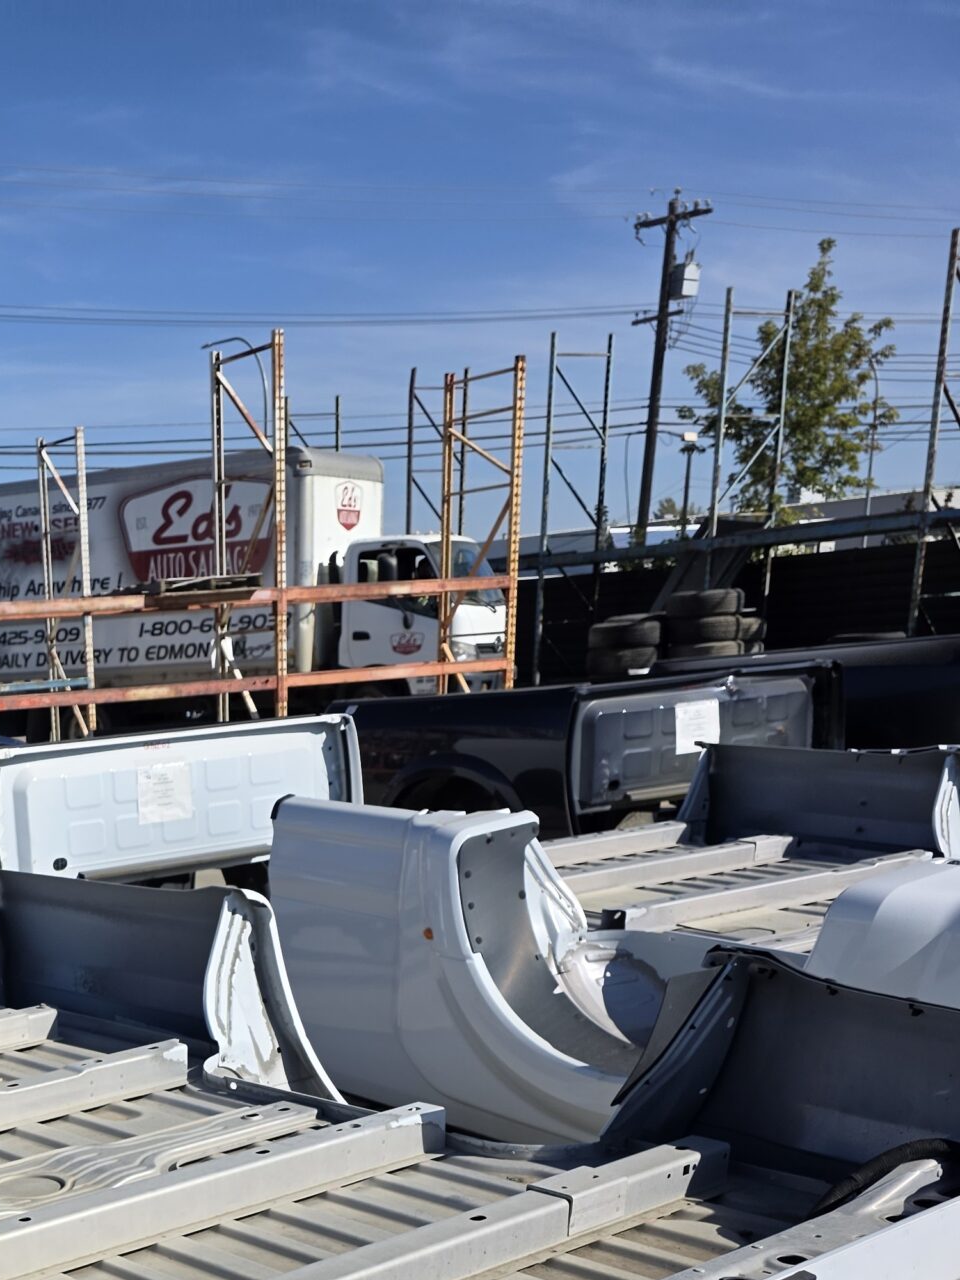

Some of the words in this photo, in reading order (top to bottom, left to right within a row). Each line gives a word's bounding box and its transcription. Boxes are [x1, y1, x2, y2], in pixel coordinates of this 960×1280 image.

[15, 502, 46, 519] Cana
[52, 501, 80, 514] sinc
[0, 520, 34, 539] NEW
[146, 551, 186, 584] AUTO
[191, 545, 252, 578] SALAG
[25, 575, 111, 597] Anwhre
[139, 612, 292, 638] 1-800-61-903
[36, 647, 113, 668] DLIVERY
[118, 645, 139, 663] TO
[145, 638, 248, 662] EDMONN
